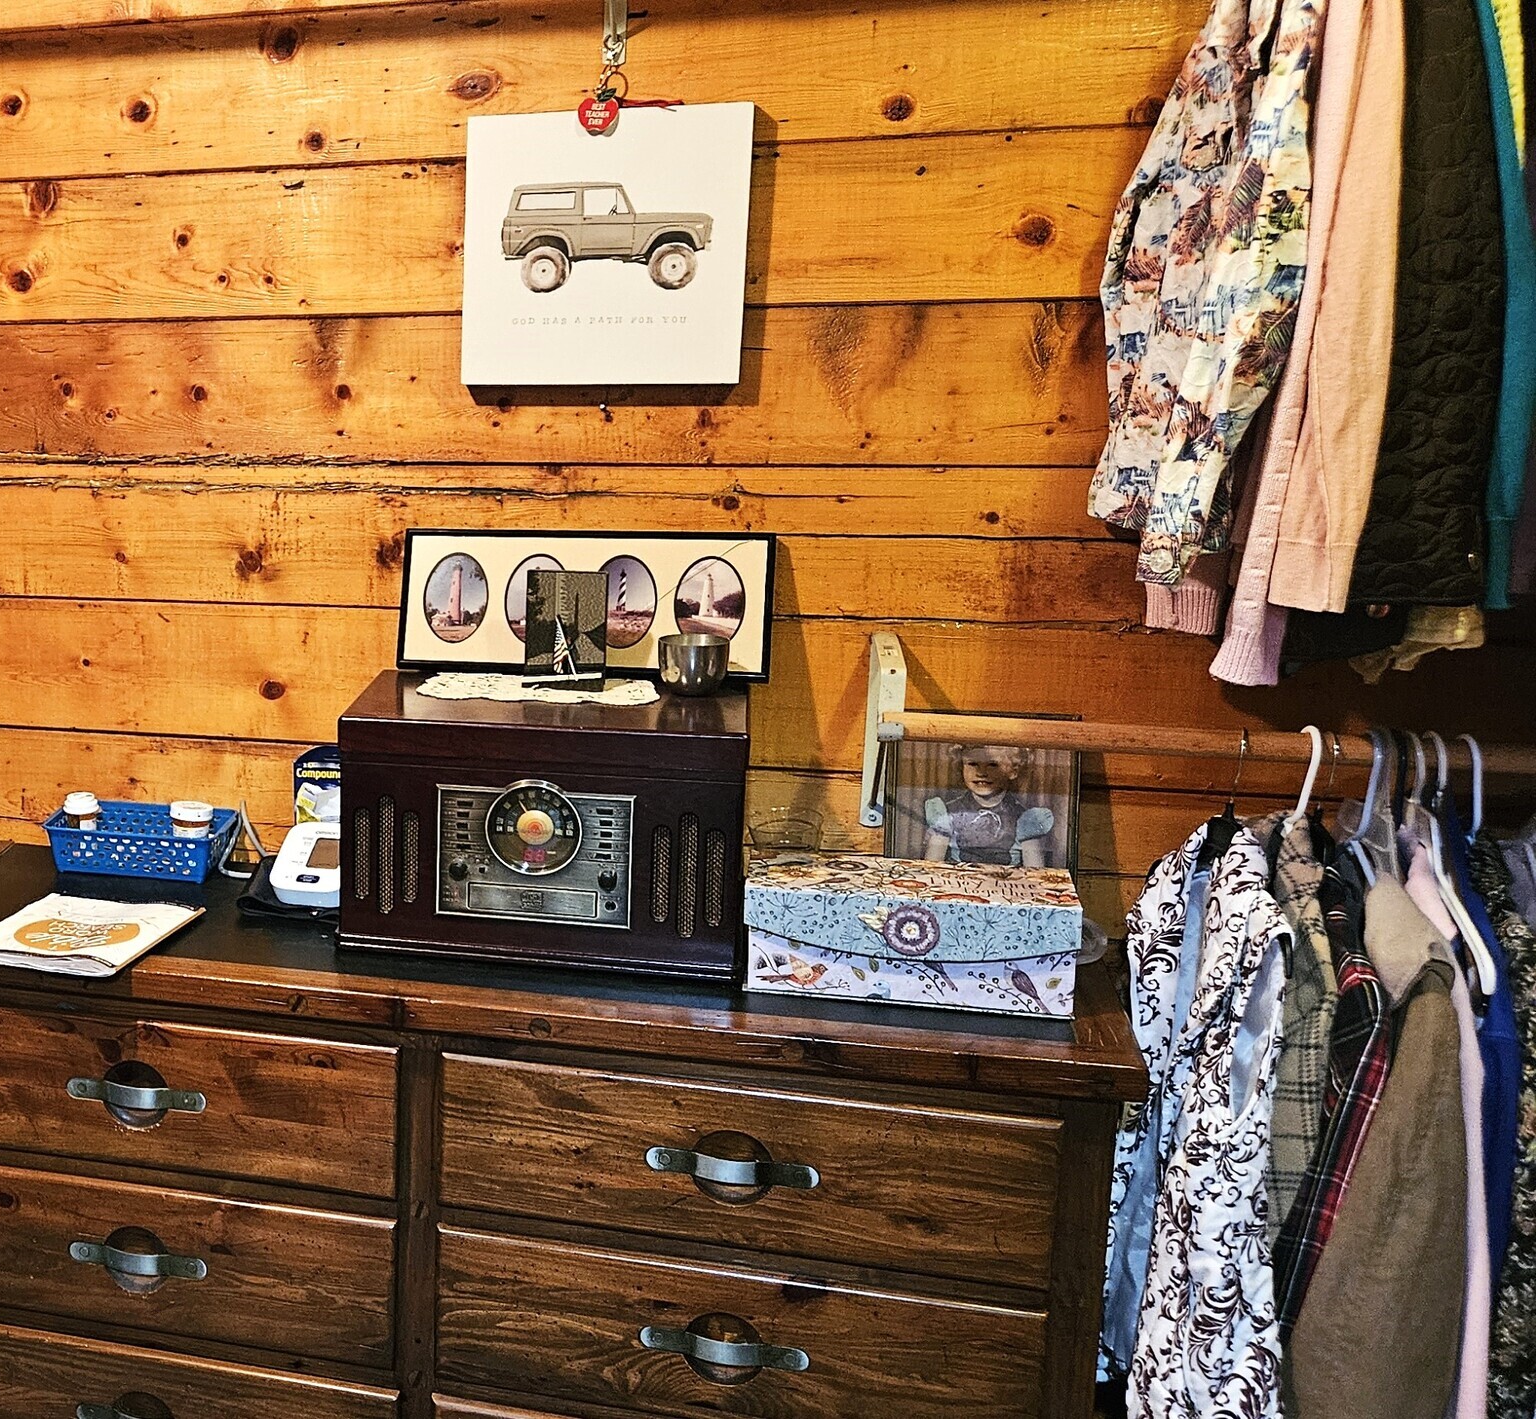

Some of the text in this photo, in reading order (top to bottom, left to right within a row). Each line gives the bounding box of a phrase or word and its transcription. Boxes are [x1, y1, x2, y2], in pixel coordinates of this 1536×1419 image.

[585, 110, 610, 118] TEACHER
[511, 315, 688, 326] GOD HAS A PATH FOR YOU
[964, 887, 1035, 898] together
[48, 921, 127, 931] SEARCH
[48, 927, 108, 937] WORD
